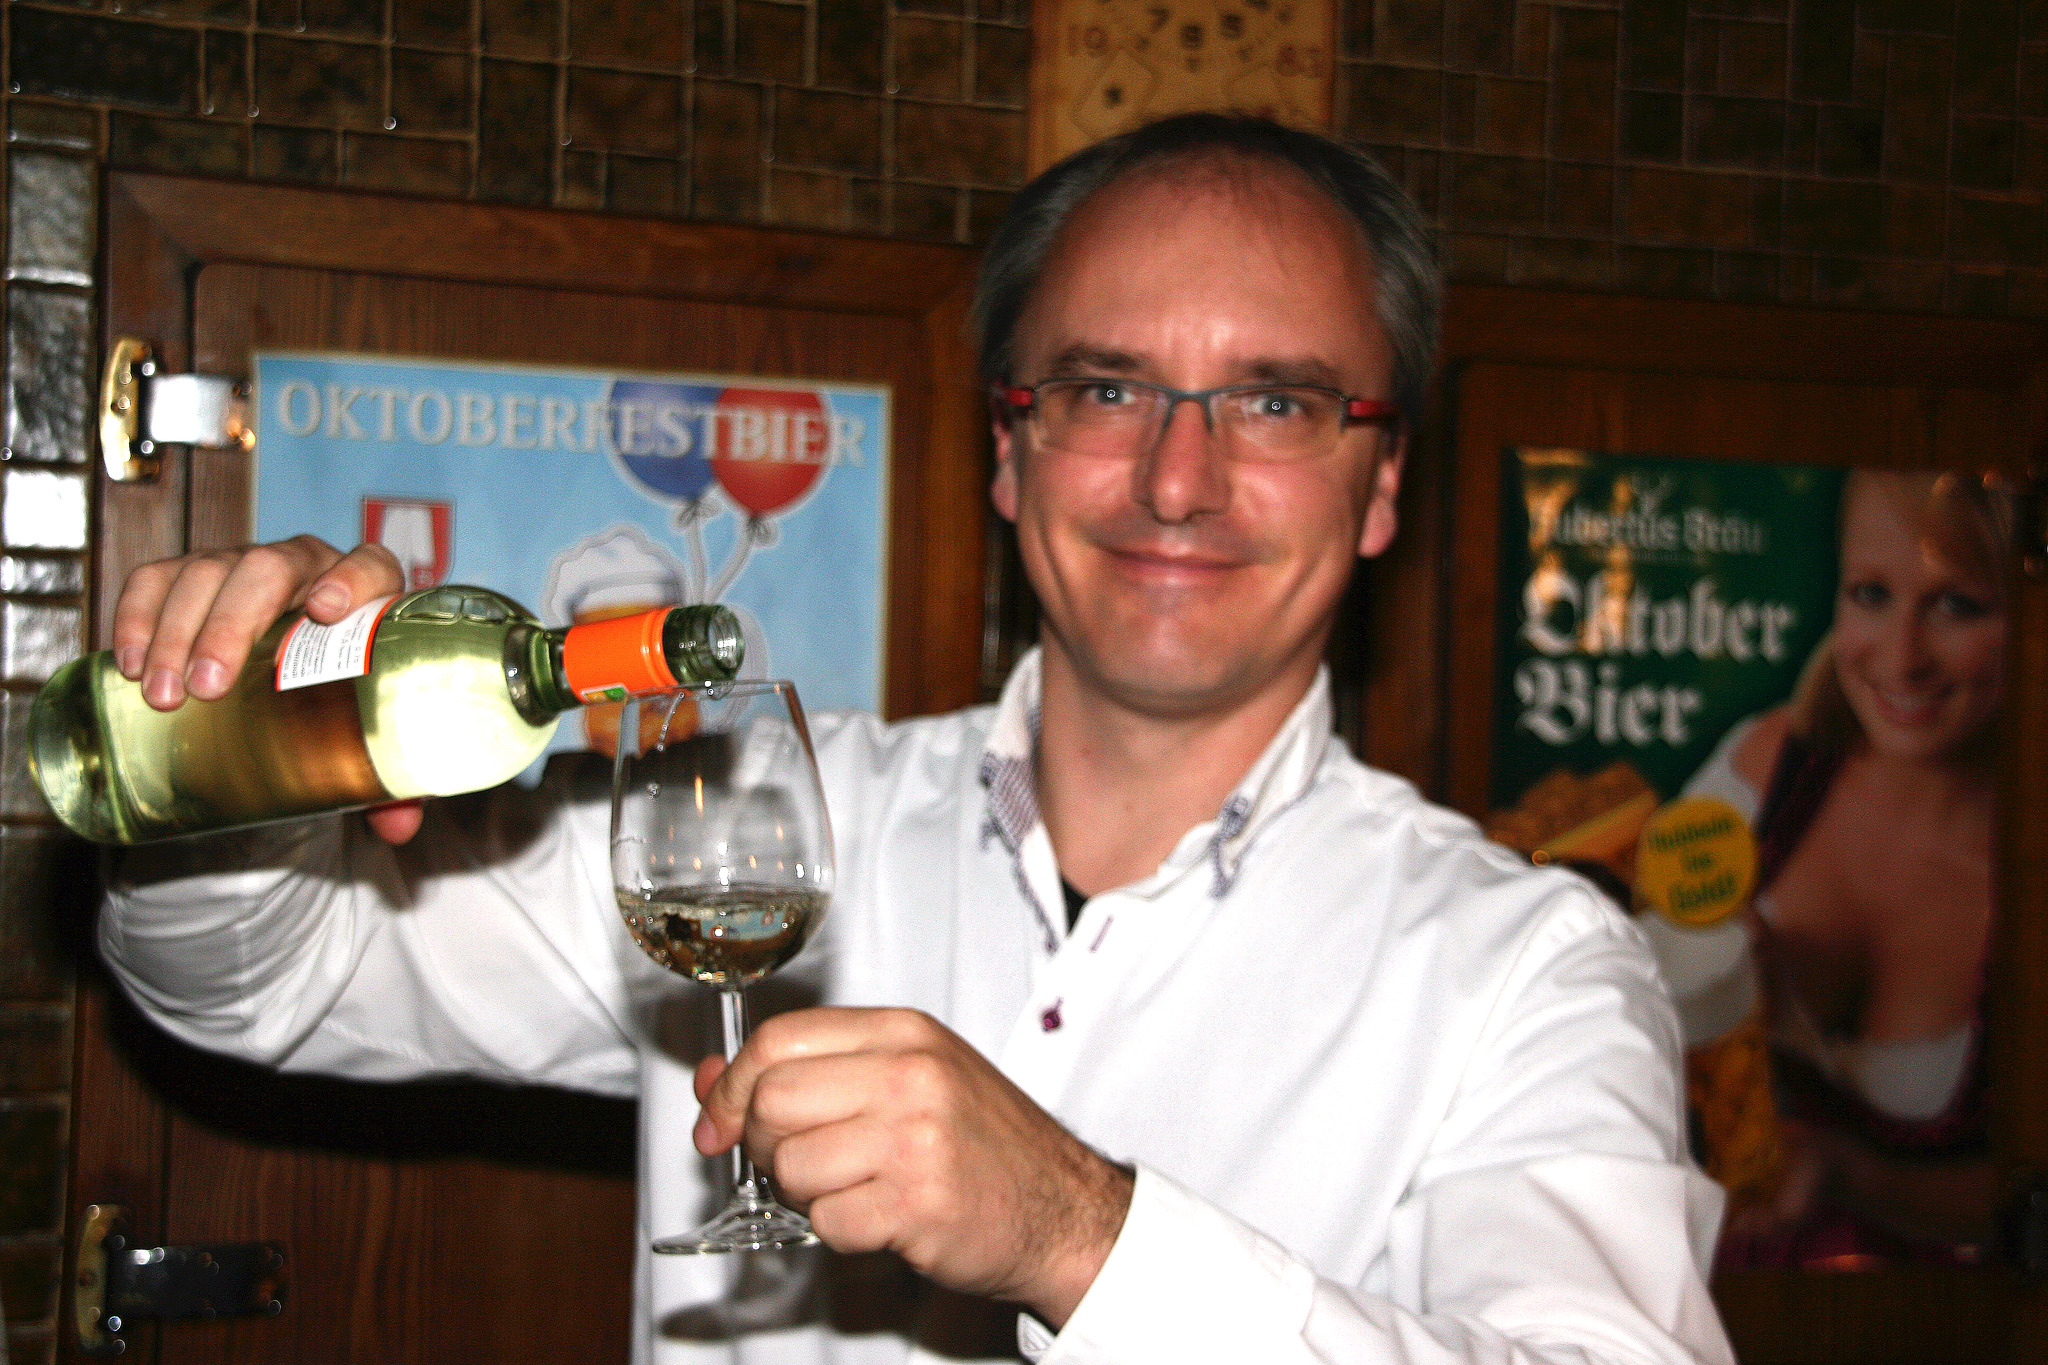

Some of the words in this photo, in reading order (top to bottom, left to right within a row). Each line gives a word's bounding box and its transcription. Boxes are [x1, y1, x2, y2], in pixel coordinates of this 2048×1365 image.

[276, 380, 868, 467] OKTOBERFESTBIER
[1520, 566, 1796, 662] Oktober
[1514, 658, 1702, 747] Bier
